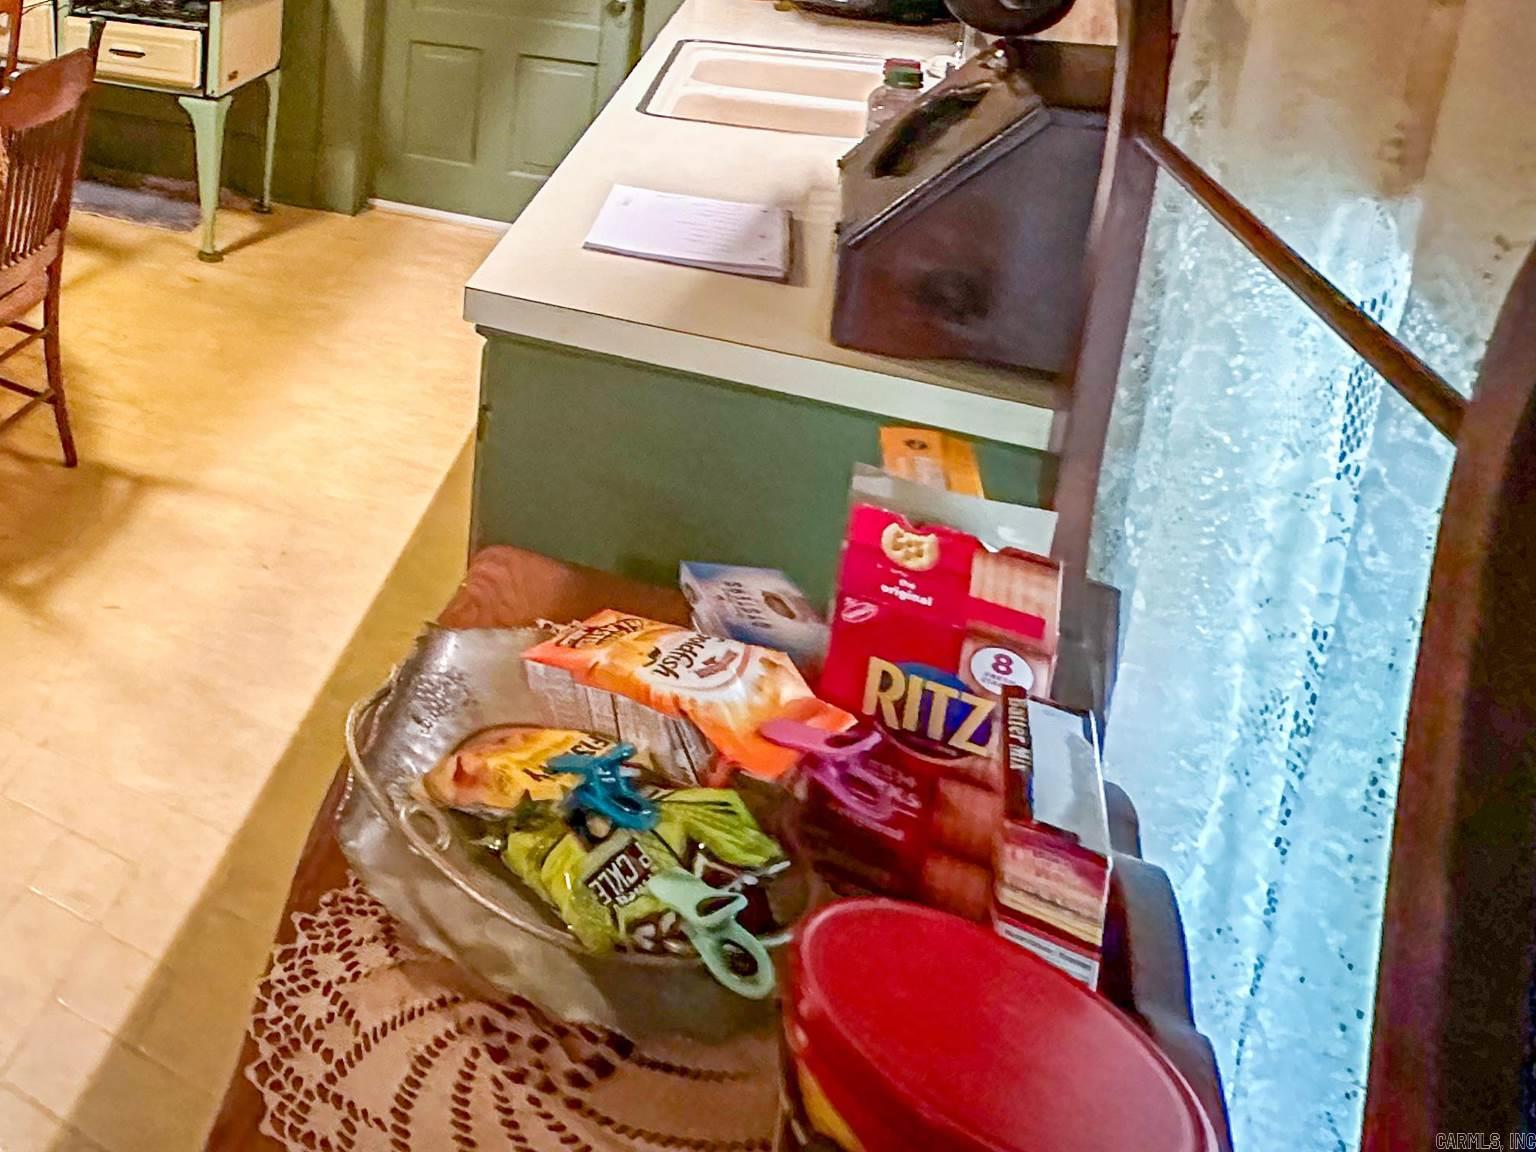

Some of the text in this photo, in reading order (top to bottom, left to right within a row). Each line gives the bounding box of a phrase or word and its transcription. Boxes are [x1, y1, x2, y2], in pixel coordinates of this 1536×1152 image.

[880, 583, 934, 607] original
[898, 578, 917, 590] the
[652, 633, 716, 680] oldfish
[992, 653, 1013, 675] 8
[862, 656, 997, 758] RITZ
